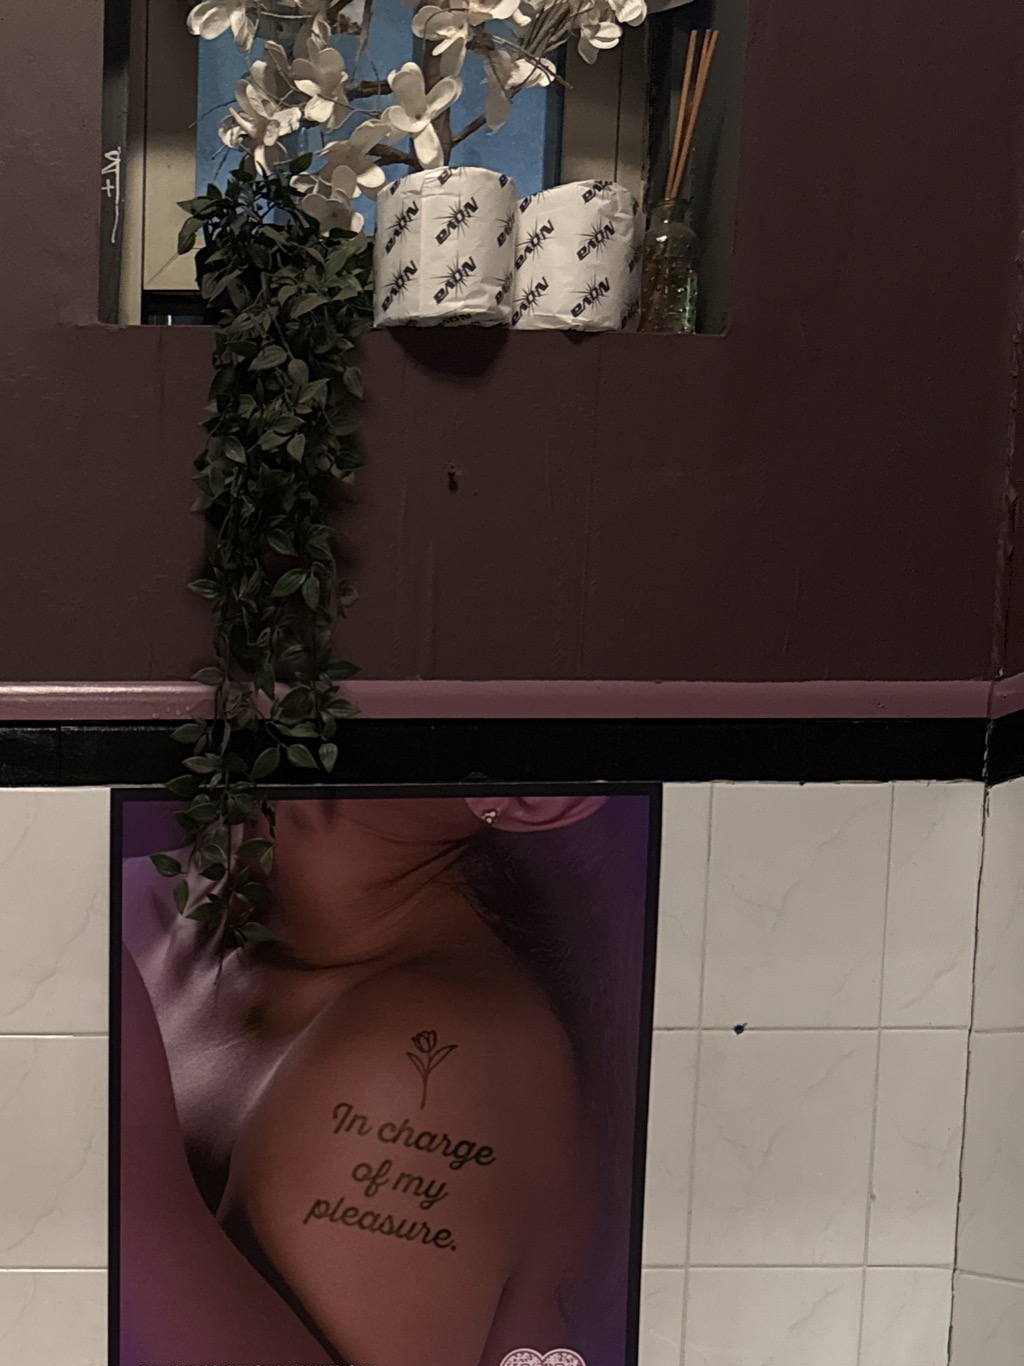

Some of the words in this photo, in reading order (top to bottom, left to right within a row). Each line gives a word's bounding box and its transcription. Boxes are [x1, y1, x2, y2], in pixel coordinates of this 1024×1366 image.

[385, 200, 419, 254] Nova
[435, 197, 480, 245] Nova
[514, 219, 555, 270] Nova
[576, 220, 616, 261] Nova
[381, 260, 418, 312] Nova
[433, 256, 477, 305] Nova
[511, 276, 549, 327] Nova
[570, 277, 610, 319] Nova
[331, 1102, 372, 1136] In
[377, 1118, 497, 1171] charge
[351, 1159, 393, 1198] of
[392, 1171, 448, 1210] my
[303, 1196, 457, 1251] pleasure.
